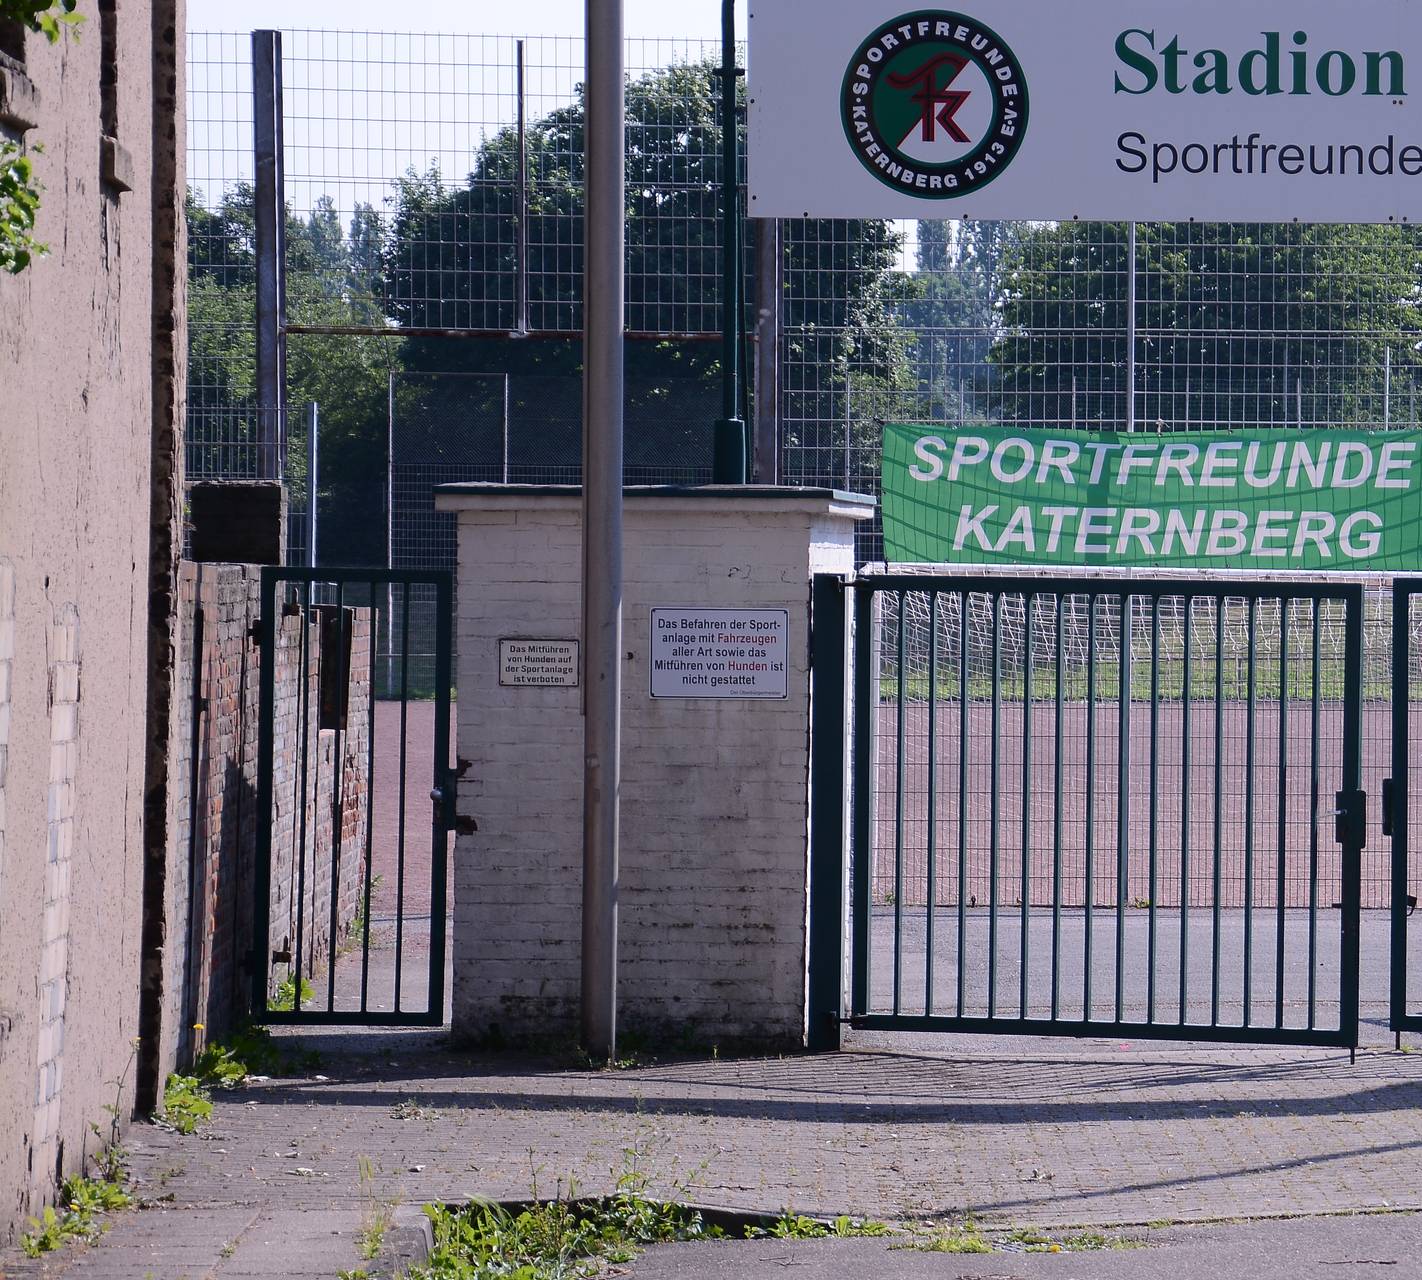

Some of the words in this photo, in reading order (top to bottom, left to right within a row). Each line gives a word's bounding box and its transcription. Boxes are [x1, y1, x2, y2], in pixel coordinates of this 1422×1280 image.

[852, 21, 1018, 97] SPORTFREUNDE
[1114, 28, 1408, 96] Stadion
[852, 105, 958, 188] KATERNBERG
[964, 141, 1005, 180] 1913
[908, 435, 1417, 489] SPORTFREUNDE
[952, 504, 1384, 557] KATERNBERG
[657, 619, 677, 629] Das
[680, 619, 727, 629] Befahren
[730, 619, 747, 630] der
[749, 619, 781, 631] Sport-
[662, 633, 696, 645] anlage
[698, 633, 715, 643] mit
[717, 633, 777, 645] Fahrzeugen
[509, 645, 526, 653] Das
[528, 645, 570, 653] Mitführen
[672, 647, 694, 657] aller
[696, 647, 713, 657] Art
[715, 647, 745, 657] sowie
[748, 647, 767, 657] das
[524, 655, 556, 663] Hunden
[557, 655, 572, 663] auf
[505, 665, 519, 673] der
[520, 665, 573, 674] Sportanlage
[654, 659, 703, 671] Mitführen
[706, 662, 725, 671] von
[728, 660, 768, 671] Hunden
[770, 661, 784, 672] ist
[513, 675, 525, 683] ist
[526, 675, 565, 683] verboten
[682, 674, 708, 685] nicht
[710, 674, 756, 687] gestattet
